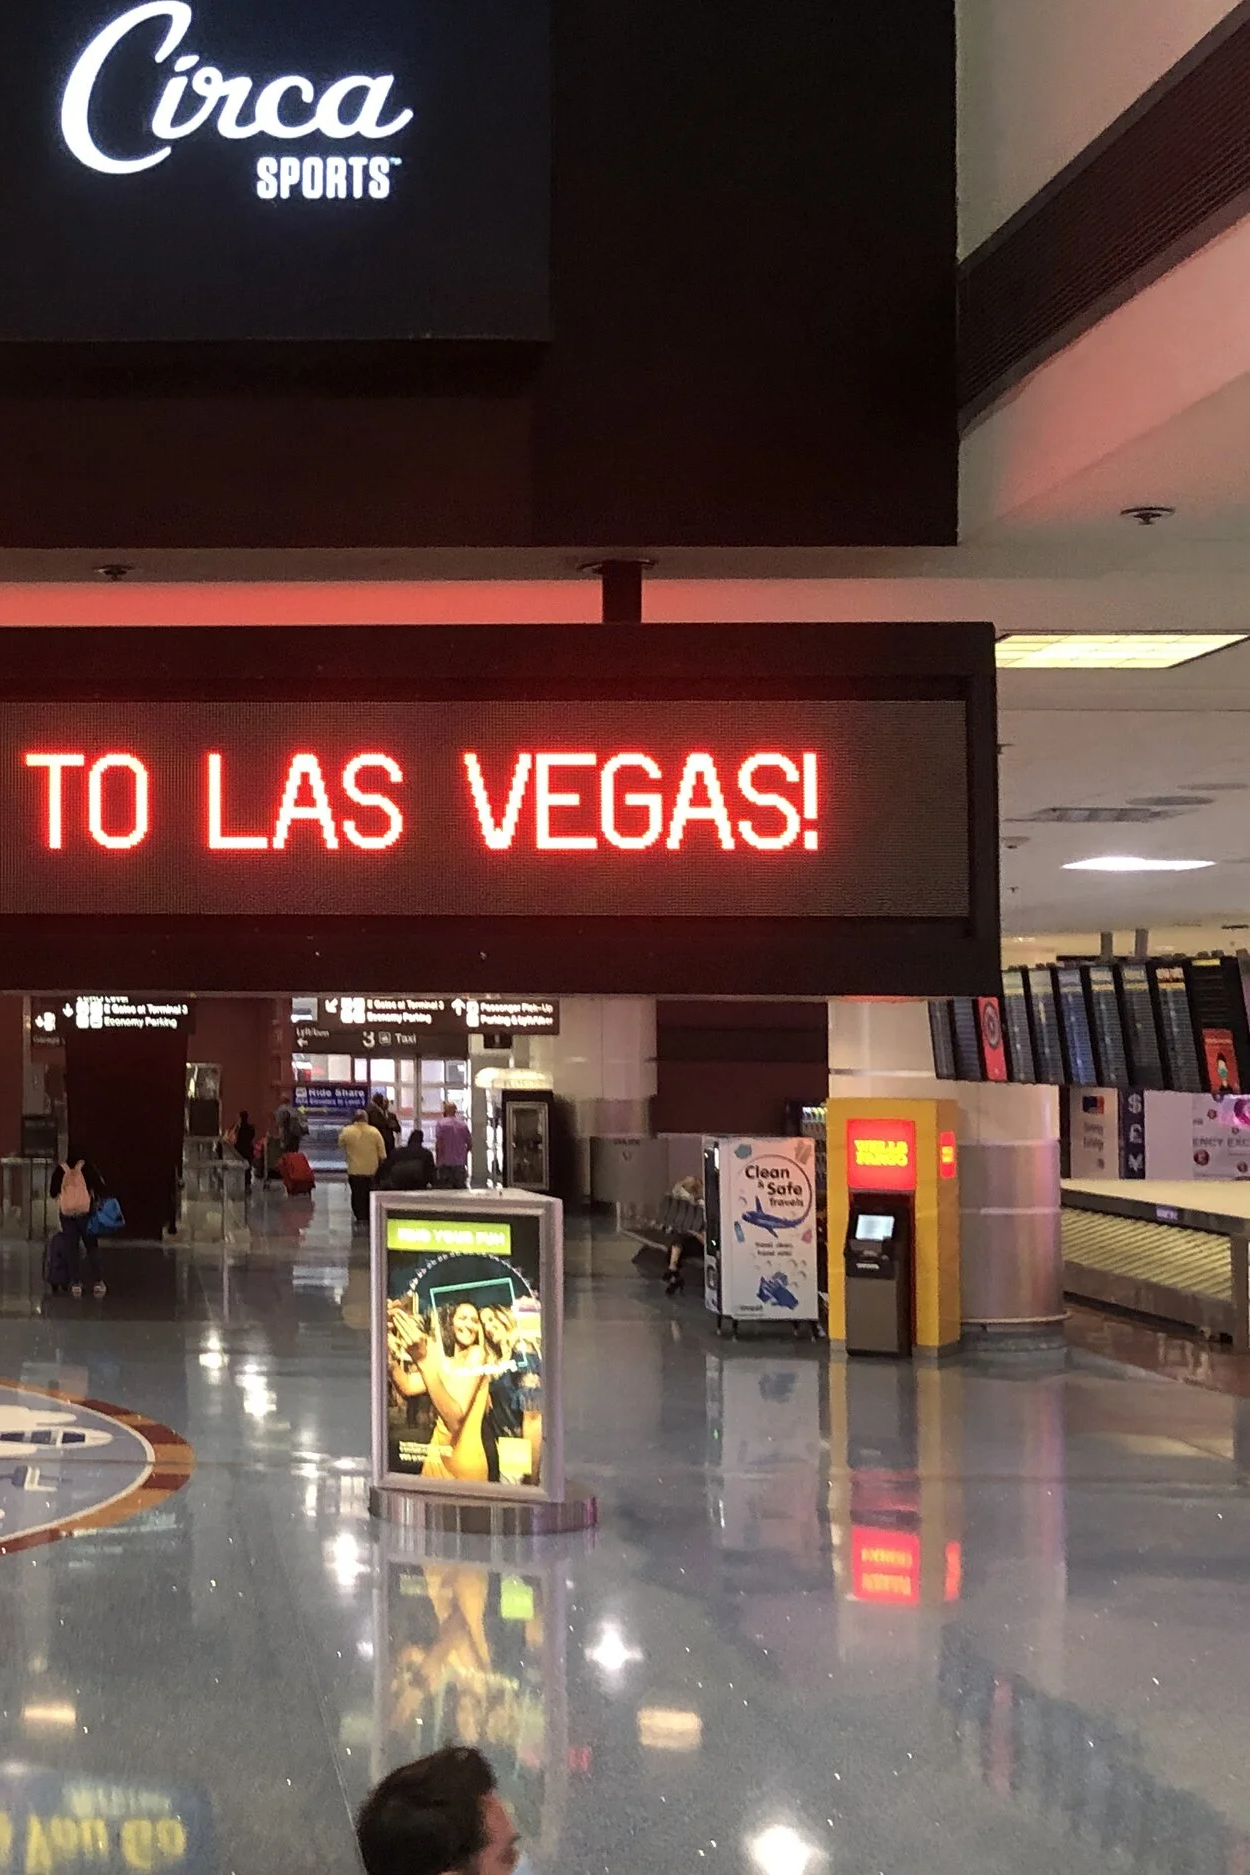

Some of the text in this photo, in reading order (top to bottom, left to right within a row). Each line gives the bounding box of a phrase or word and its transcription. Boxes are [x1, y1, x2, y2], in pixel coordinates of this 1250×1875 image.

[61, 0, 414, 174] Circa
[25, 752, 151, 850] TO
[208, 752, 404, 850] LAS
[463, 752, 820, 851] VEGAS!
[147, 1003, 181, 1015] Terminal
[104, 1017, 178, 1029] Economy Parking
[362, 1031, 417, 1049] 3 Taxi
[1127, 1092, 1142, 1114] $
[745, 1164, 790, 1179] Clean
[767, 1182, 803, 1196] Safe
